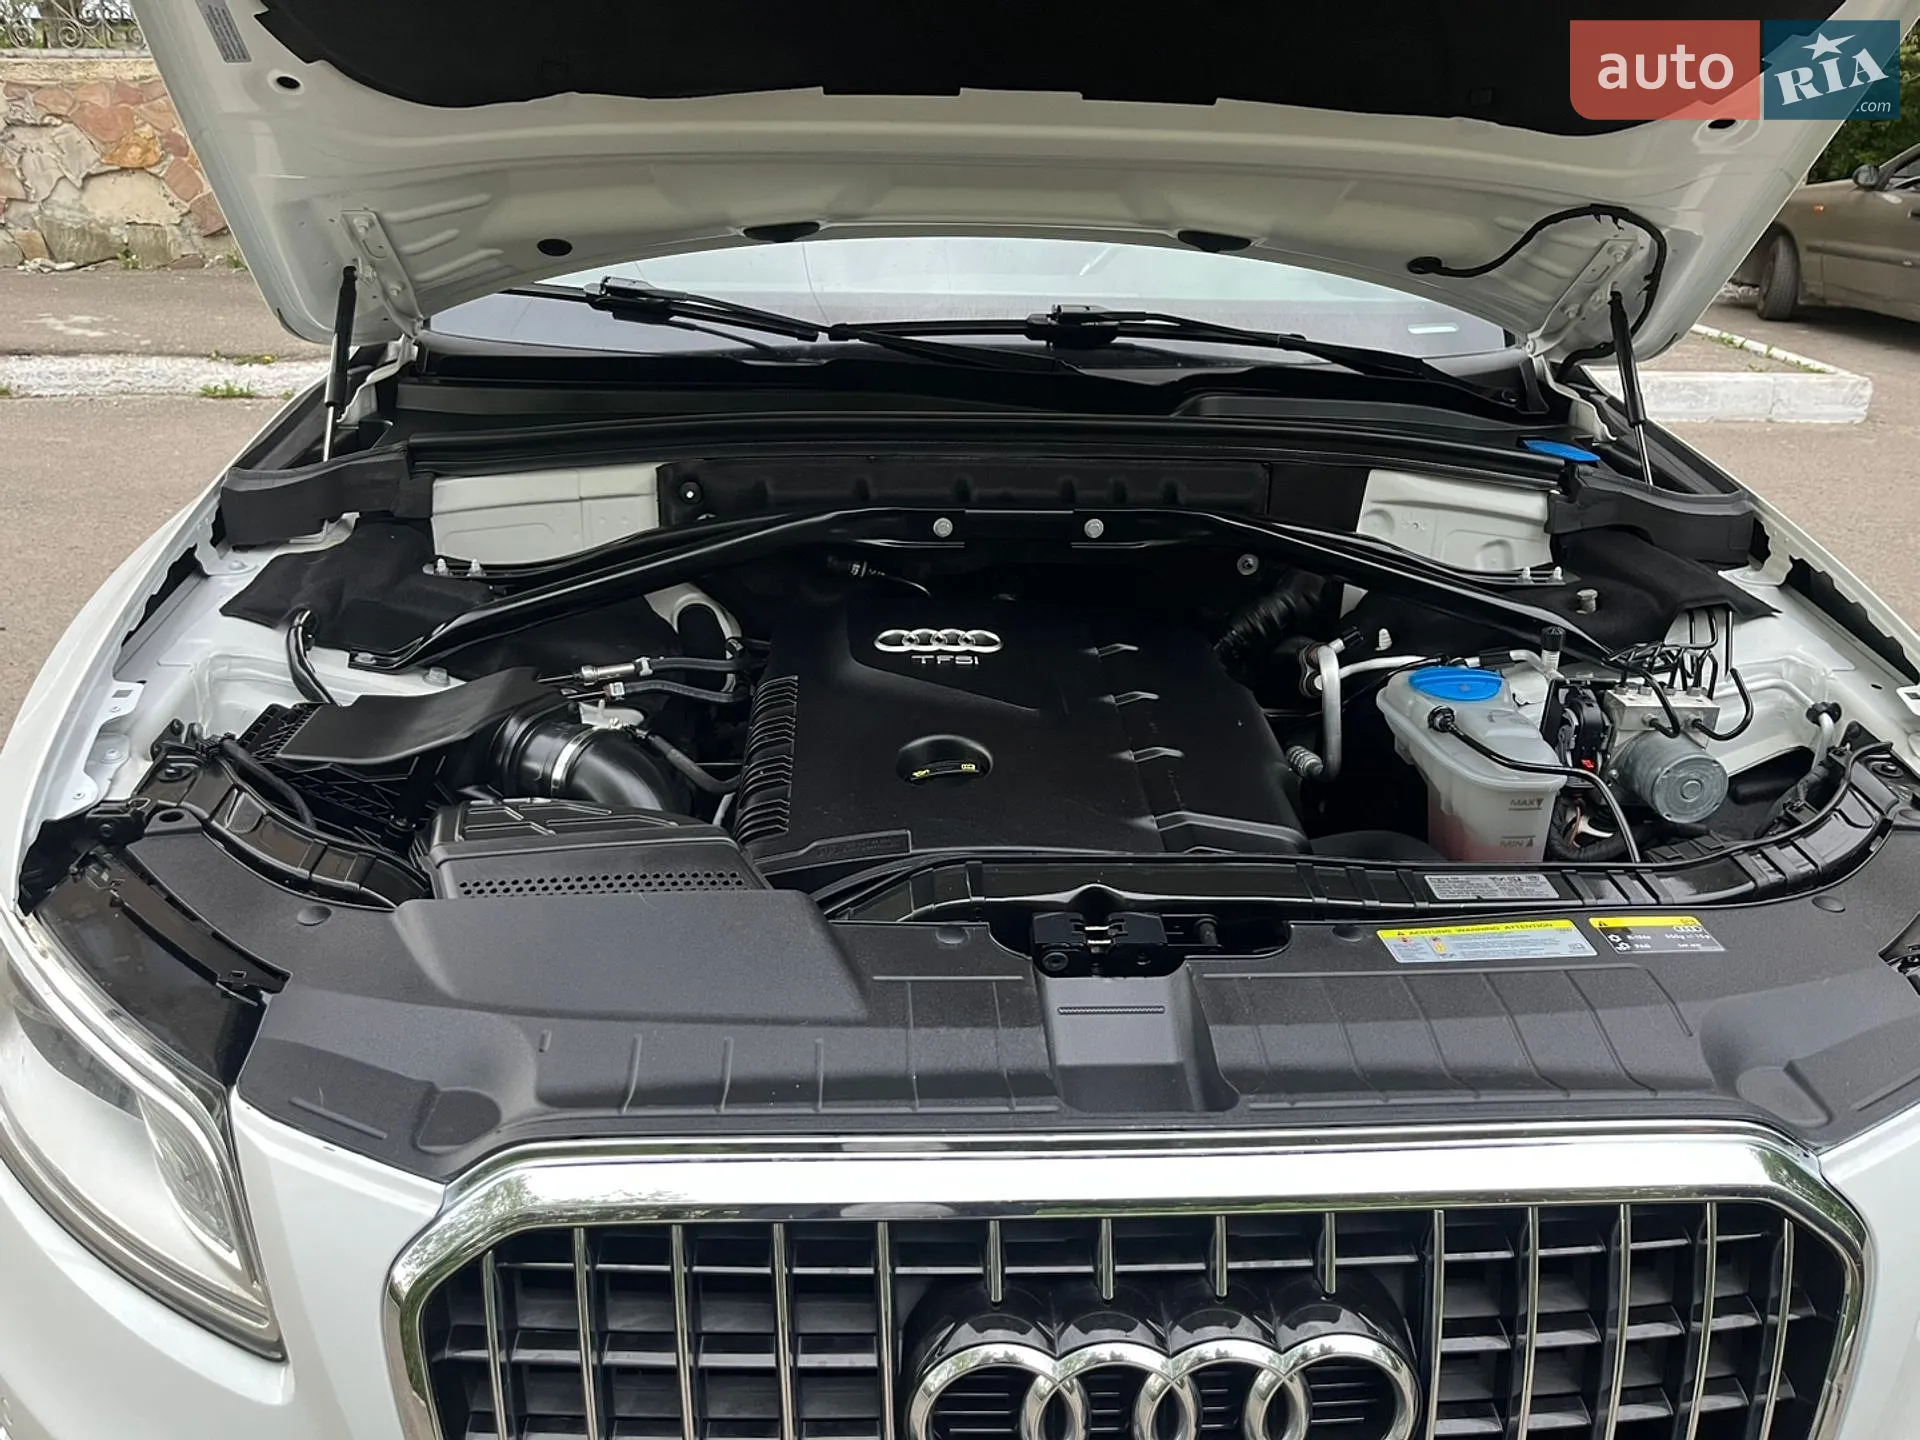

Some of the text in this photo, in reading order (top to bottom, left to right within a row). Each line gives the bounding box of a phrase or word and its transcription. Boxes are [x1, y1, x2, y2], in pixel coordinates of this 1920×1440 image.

[911, 655, 979, 664] TFSI
[1510, 798, 1536, 806] MAX
[1500, 839, 1524, 848] MIN
[1408, 921, 1554, 936] ACHTUNG WARNING ATTENTION
